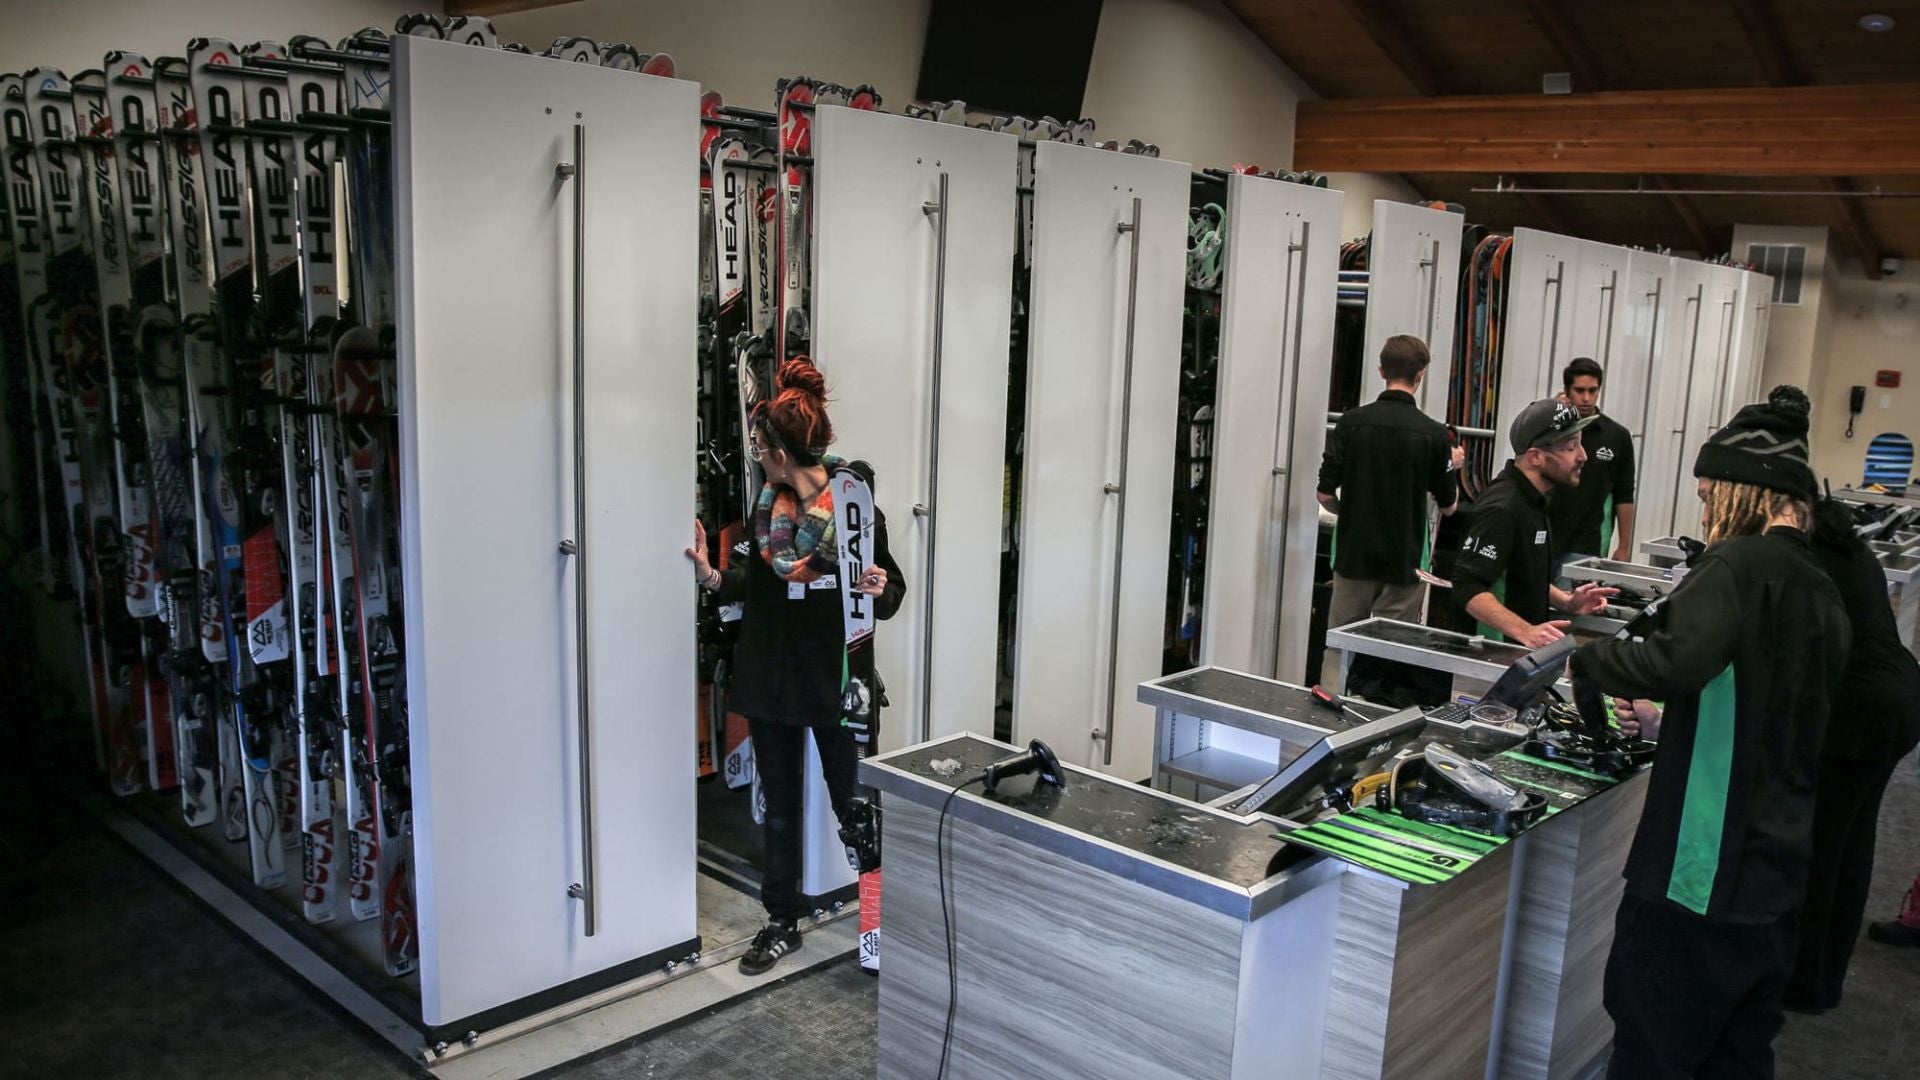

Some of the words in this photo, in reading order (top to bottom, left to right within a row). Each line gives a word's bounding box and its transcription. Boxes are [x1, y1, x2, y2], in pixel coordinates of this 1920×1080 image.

[4, 108, 41, 252] HEAD
[41, 105, 75, 234] HEAD
[123, 95, 154, 242] HEAD
[208, 85, 243, 247] HEAD
[259, 87, 292, 244] HEAD
[301, 82, 333, 263] HEAD
[724, 171, 738, 279] HEAD
[757, 173, 769, 306] ROSSIGNOL
[846, 502, 865, 619] HEAD
